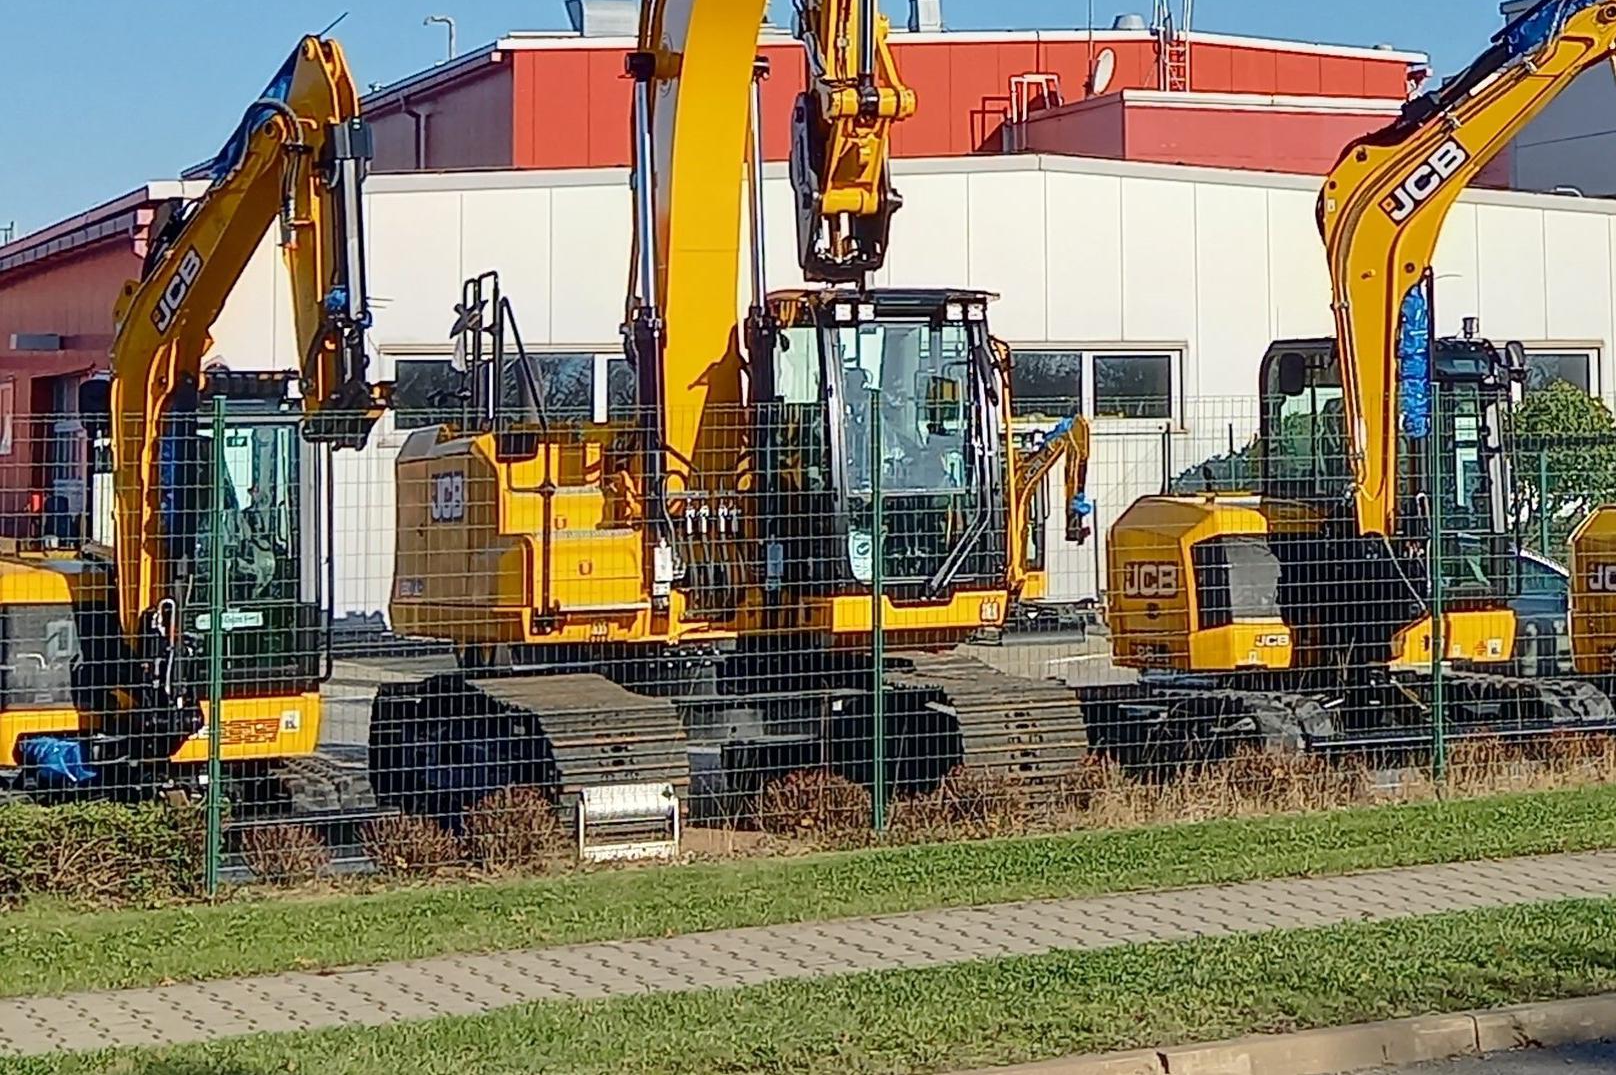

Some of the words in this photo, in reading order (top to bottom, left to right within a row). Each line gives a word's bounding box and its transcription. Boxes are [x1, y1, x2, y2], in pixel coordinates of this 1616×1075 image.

[1389, 140, 1467, 221] JCB
[157, 249, 201, 332] JCB
[431, 475, 463, 520] JCB
[1125, 563, 1178, 597] JCB
[1254, 634, 1290, 647] JCB
